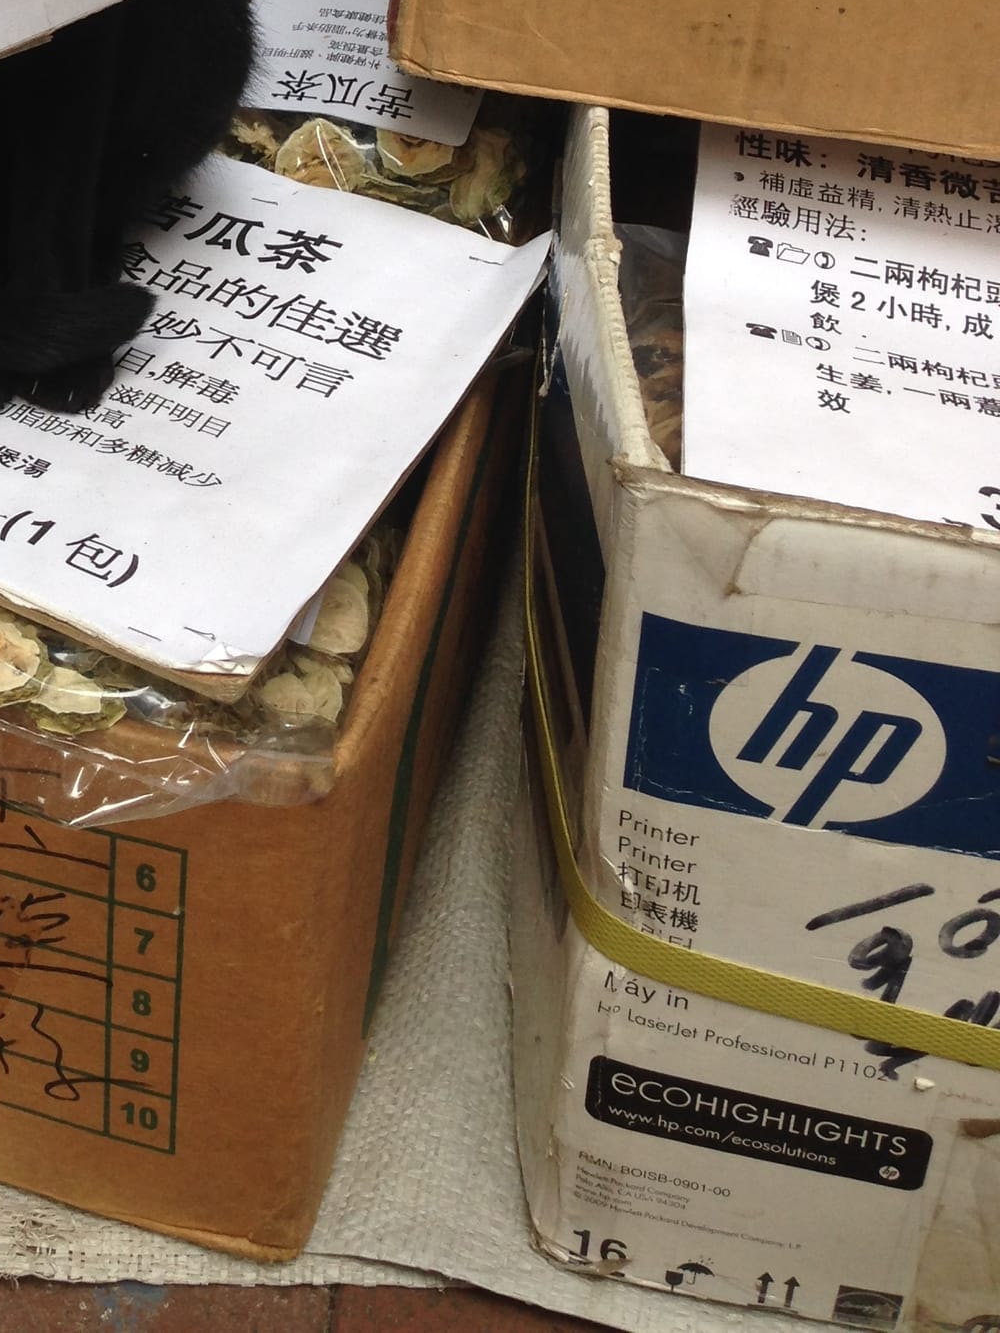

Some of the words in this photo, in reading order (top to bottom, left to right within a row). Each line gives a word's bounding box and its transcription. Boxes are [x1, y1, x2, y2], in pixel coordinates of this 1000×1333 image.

[319, 8, 388, 25] 佳健康食品
[271, 70, 414, 119] 苦瓜茶
[146, 194, 343, 274] 苦瓜茶
[810, 280, 840, 308] 煲
[851, 291, 866, 311] 2
[810, 312, 842, 335] 飲
[141, 309, 354, 398] 妙不可言
[853, 346, 1000, 390] 二兩枸杞
[817, 389, 851, 414] 效
[736, 643, 923, 830] hp
[619, 809, 700, 847] Printer
[618, 835, 697, 874] Printer
[134, 864, 156, 893] 6
[617, 861, 701, 906] 打印机
[133, 928, 154, 956] 7
[132, 990, 152, 1016] 8
[667, 989, 690, 1011] in
[628, 1007, 697, 1040] LaserJet
[704, 1029, 816, 1067] Professional
[130, 1048, 150, 1074] 9
[119, 1100, 158, 1132] 10
[607, 1104, 837, 1167] www.hp.com/ecosolutions
